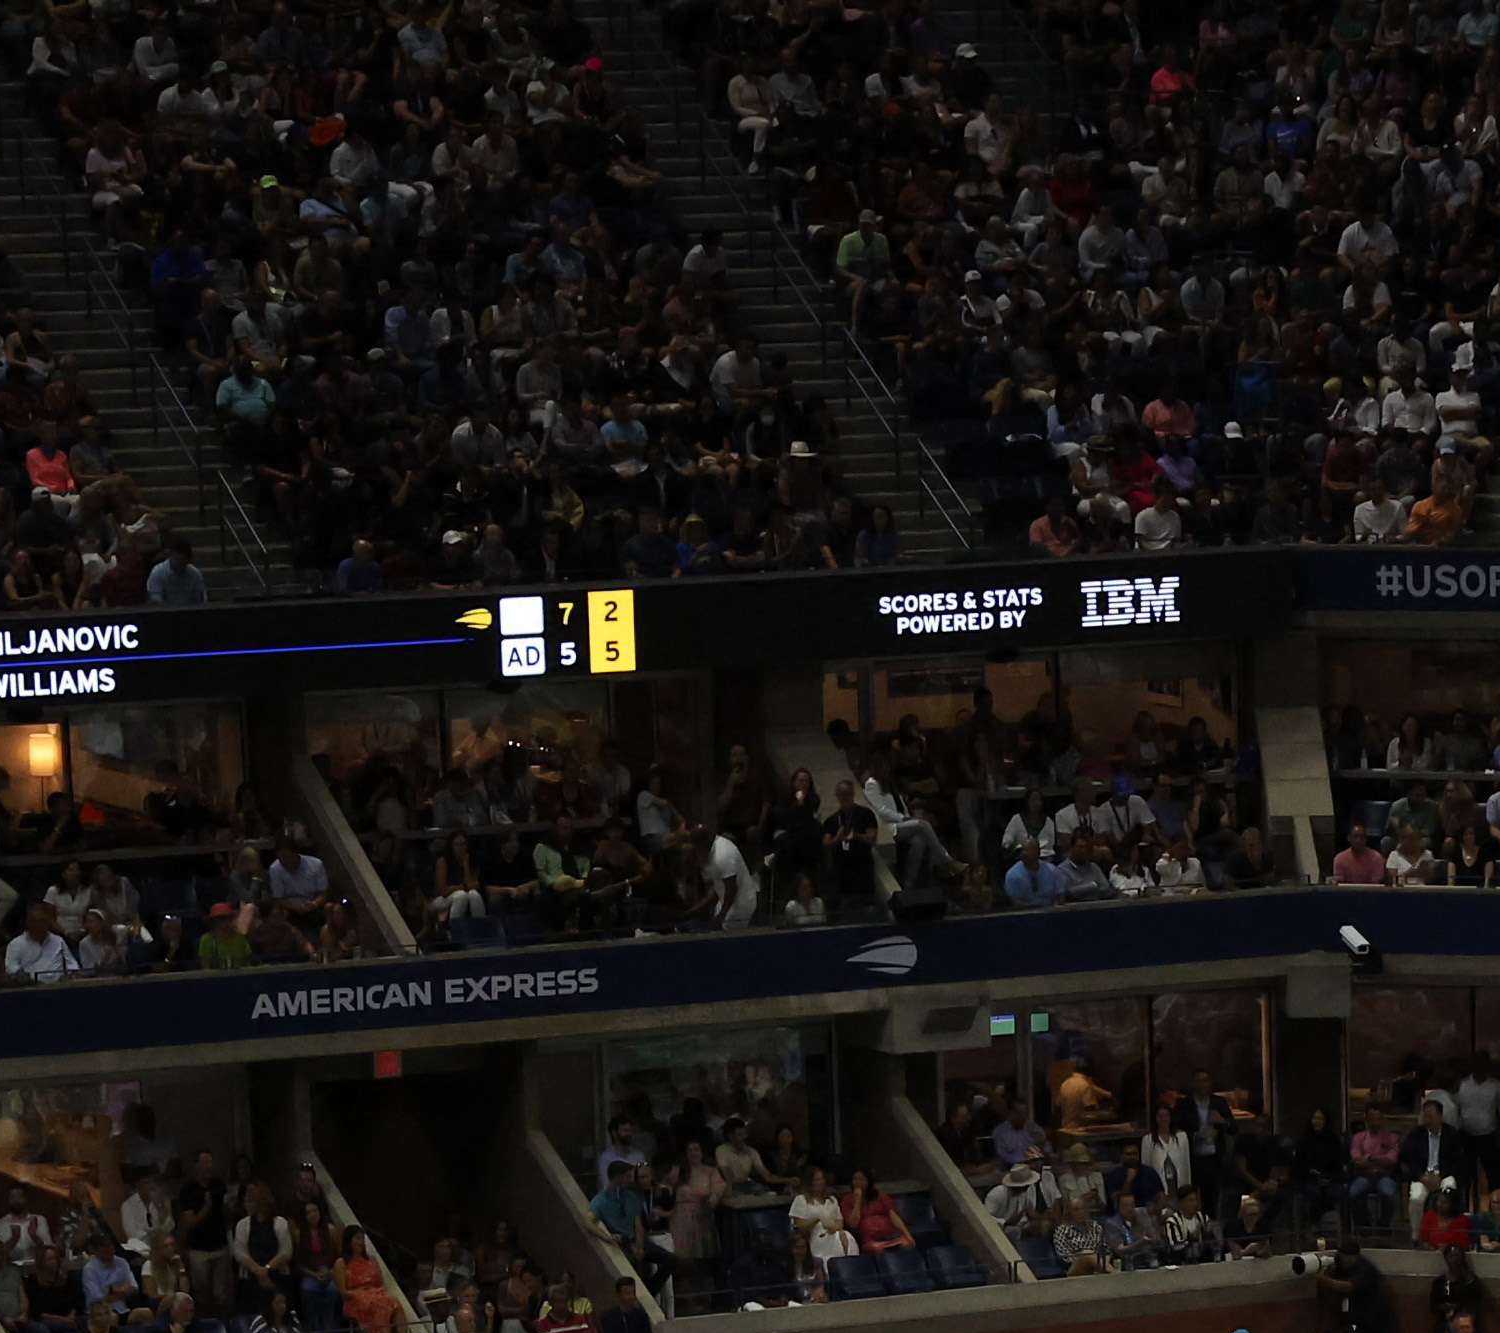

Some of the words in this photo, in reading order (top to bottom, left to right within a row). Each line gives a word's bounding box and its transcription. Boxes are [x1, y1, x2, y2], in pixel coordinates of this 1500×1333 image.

[559, 603, 573, 625] 7
[602, 601, 619, 623] 2
[879, 593, 956, 614] SCORES
[963, 592, 977, 609] &
[983, 588, 1042, 608] STATS
[1081, 577, 1180, 627] IBM
[897, 612, 994, 634] POWERED
[1000, 610, 1026, 628] BY
[506, 646, 541, 668] AD
[561, 642, 576, 665] 5
[605, 640, 620, 663] 5
[252, 981, 431, 1019] AMERICAN
[445, 968, 598, 1003] EXPRESS
